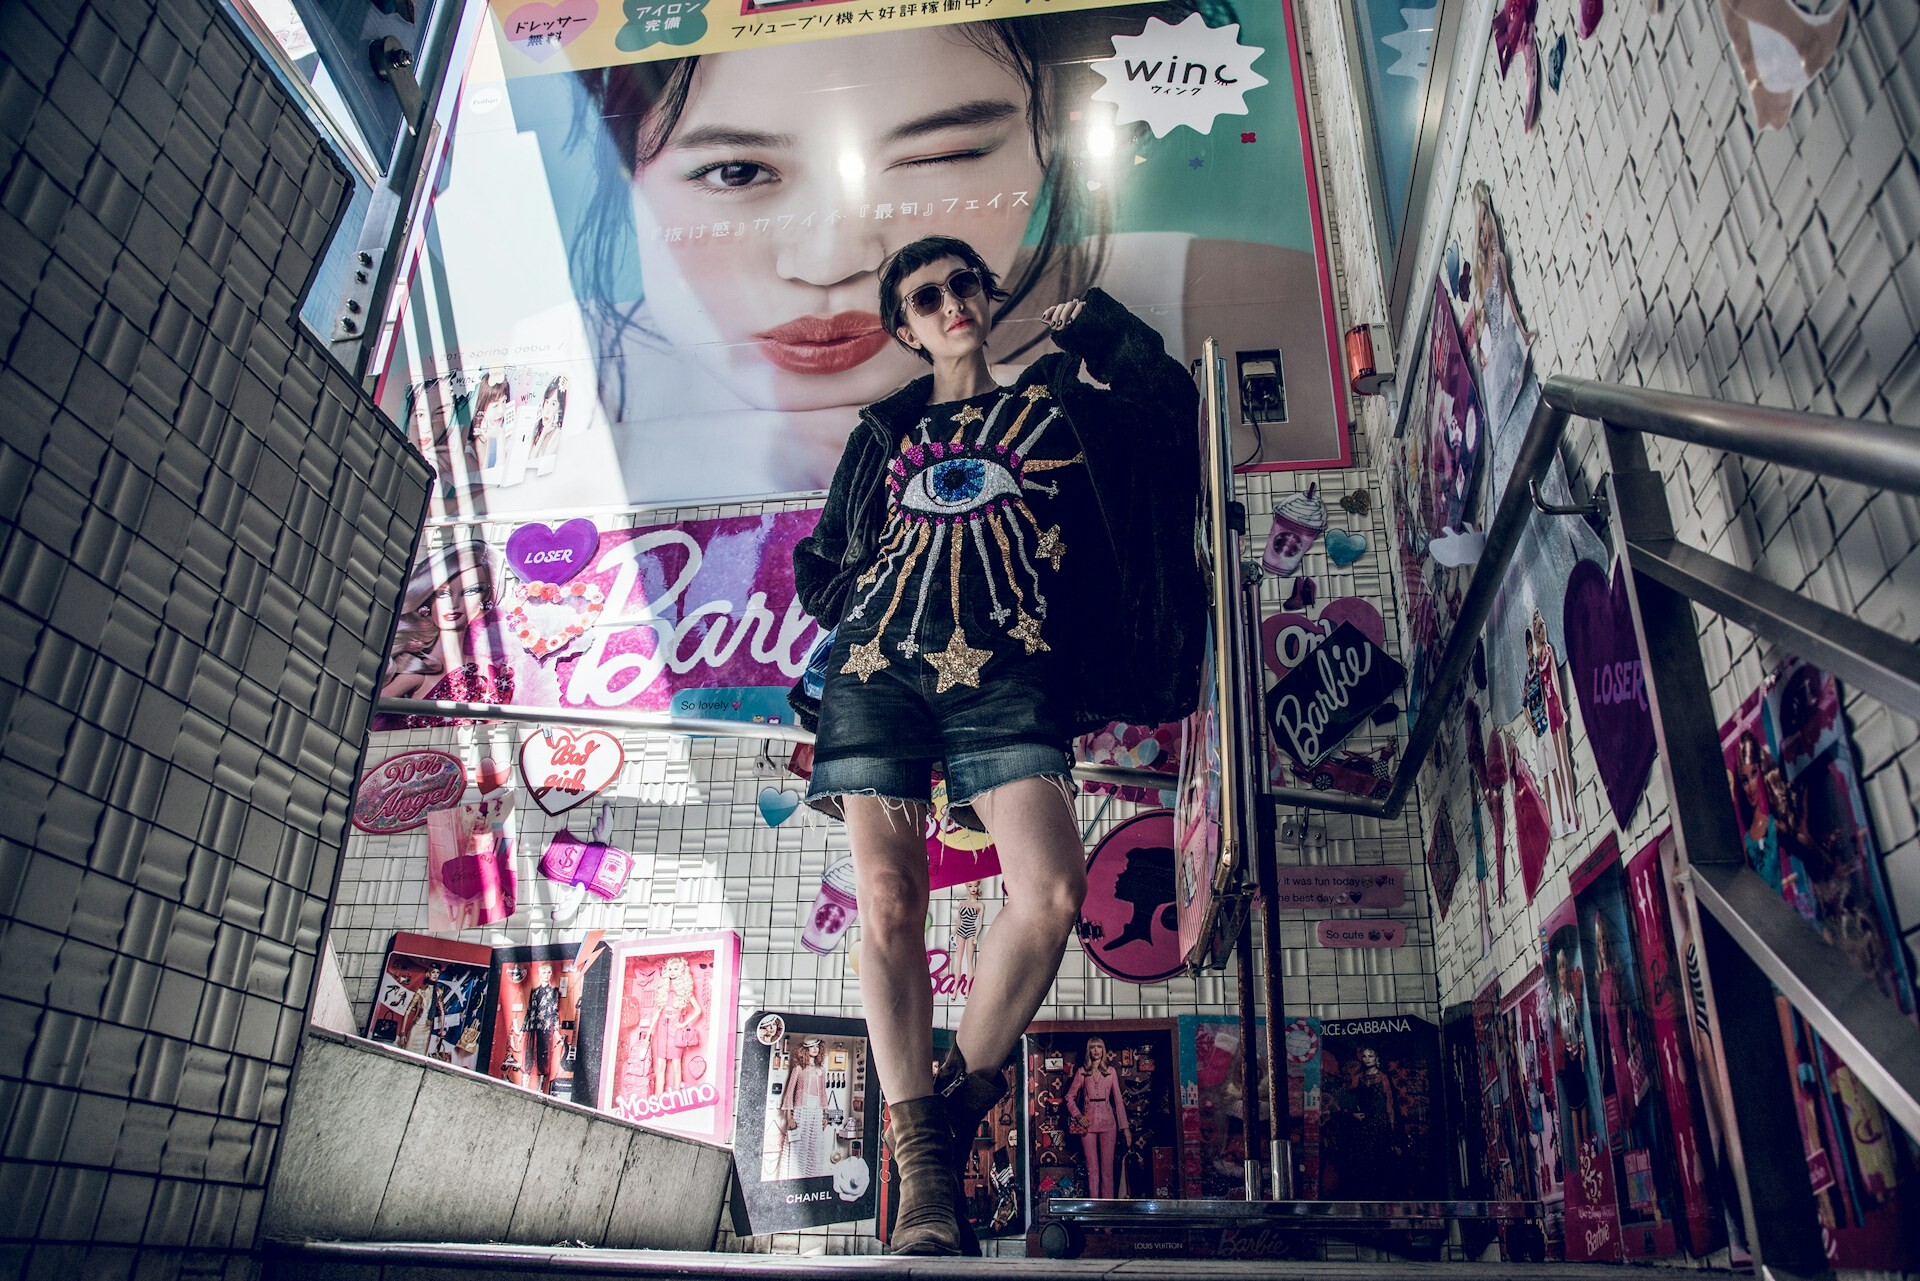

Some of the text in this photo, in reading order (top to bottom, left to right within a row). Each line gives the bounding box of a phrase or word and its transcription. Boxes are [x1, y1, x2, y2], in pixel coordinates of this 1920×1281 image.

[636, 2, 701, 19] アイロン
[516, 16, 587, 34] ドレッサー
[645, 16, 681, 32] 完備
[527, 31, 562, 47] 無料
[1124, 55, 1238, 86] winc
[1151, 85, 1202, 96] ウィング
[470, 347, 509, 359] spring
[514, 343, 551, 354] debut
[524, 547, 573, 564] LOSER
[567, 529, 830, 708] Barb
[1593, 659, 1648, 711] LOSER
[681, 699, 729, 712] So lovely
[1276, 641, 1372, 766] Barbie
[551, 738, 601, 766] Bad
[383, 754, 443, 787] 90%
[363, 775, 458, 823] Angel
[1284, 877, 1290, 886] it
[1315, 877, 1330, 886] fun
[1333, 877, 1360, 888] today
[1388, 877, 1395, 886] It
[1293, 894, 1314, 902] best
[1316, 894, 1334, 904] day
[1326, 930, 1364, 939] So cute
[1346, 1018, 1412, 1035] GABBANA
[616, 1083, 717, 1120] Moschino
[786, 1190, 832, 1204] CHANEL
[1134, 1242, 1153, 1250] LOUIS
[1217, 1228, 1290, 1256] Barbie
[1585, 1221, 1610, 1256] Barbie
